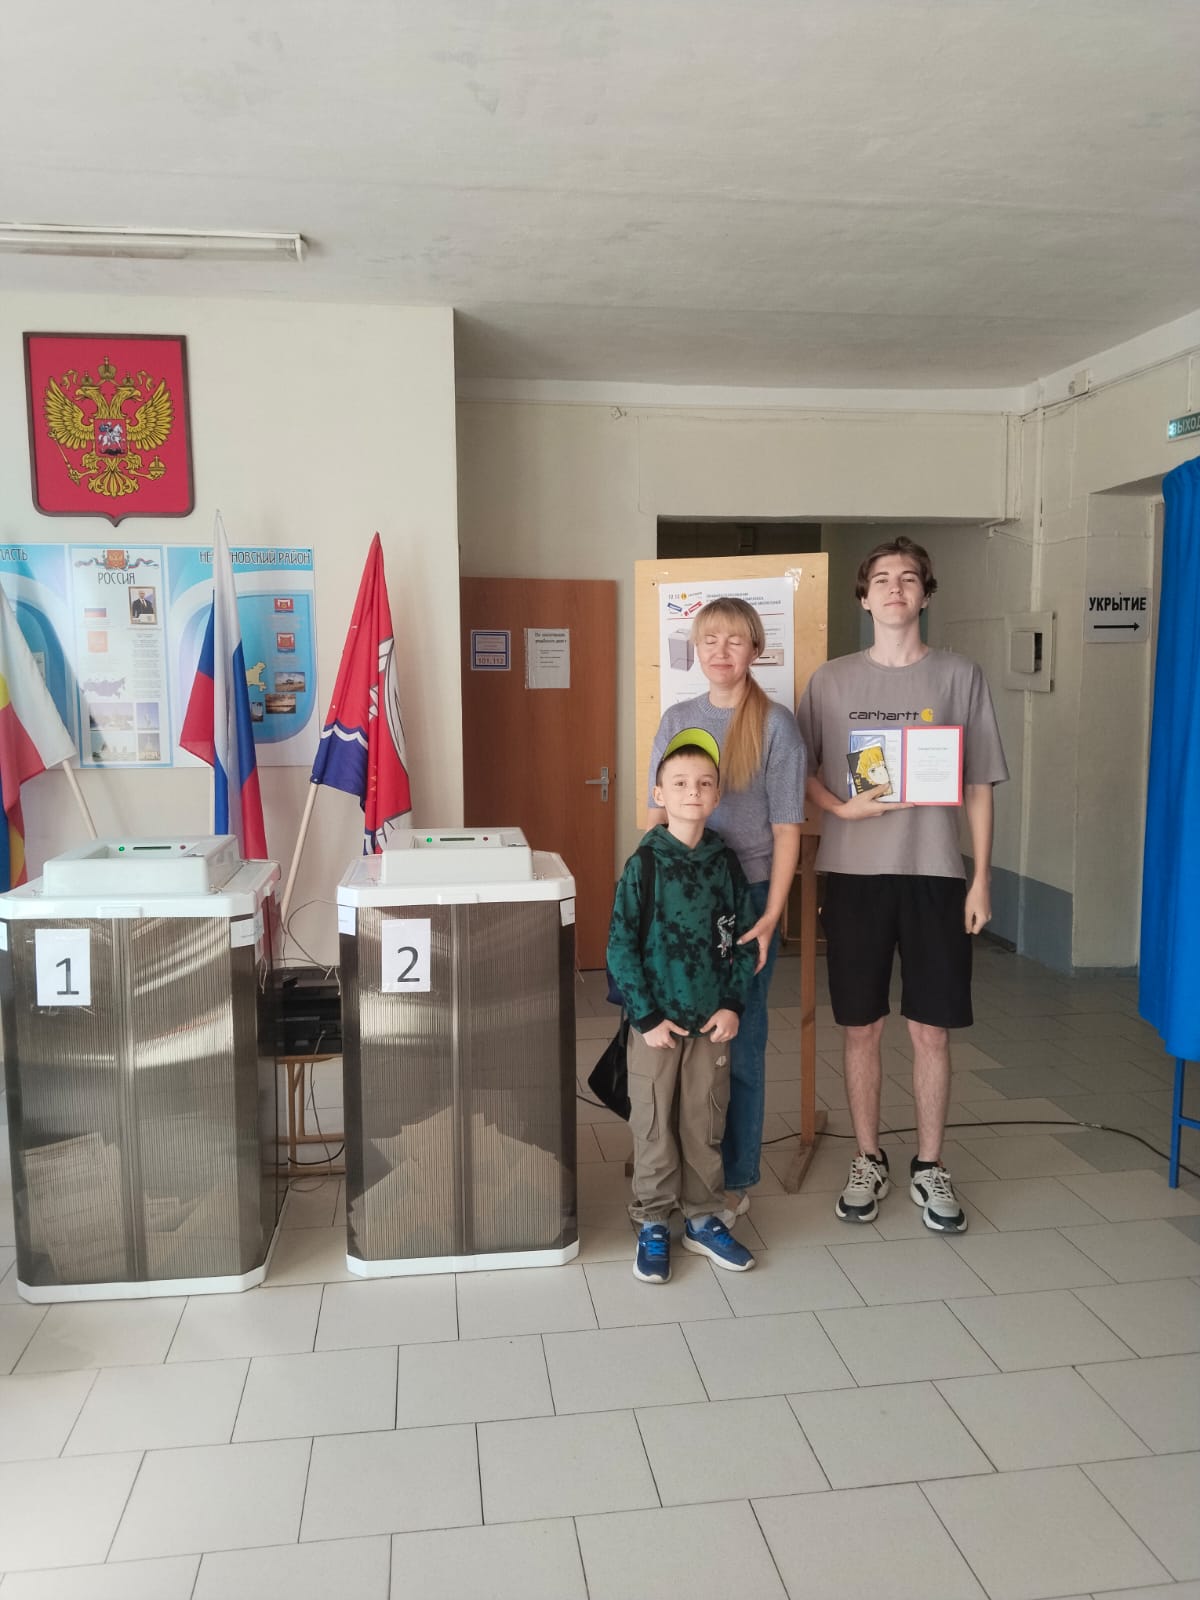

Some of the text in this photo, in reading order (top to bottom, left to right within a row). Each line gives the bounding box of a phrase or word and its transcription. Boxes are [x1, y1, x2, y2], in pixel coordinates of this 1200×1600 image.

[199, 550, 310, 565] НЕНОВСКИЙ РАЙОН
[97, 572, 136, 585] РОССИЯ
[1089, 596, 1147, 612] УКРЫТИЕ
[848, 710, 920, 721] carhartt
[397, 946, 421, 983] 2
[56, 957, 80, 996] 1
